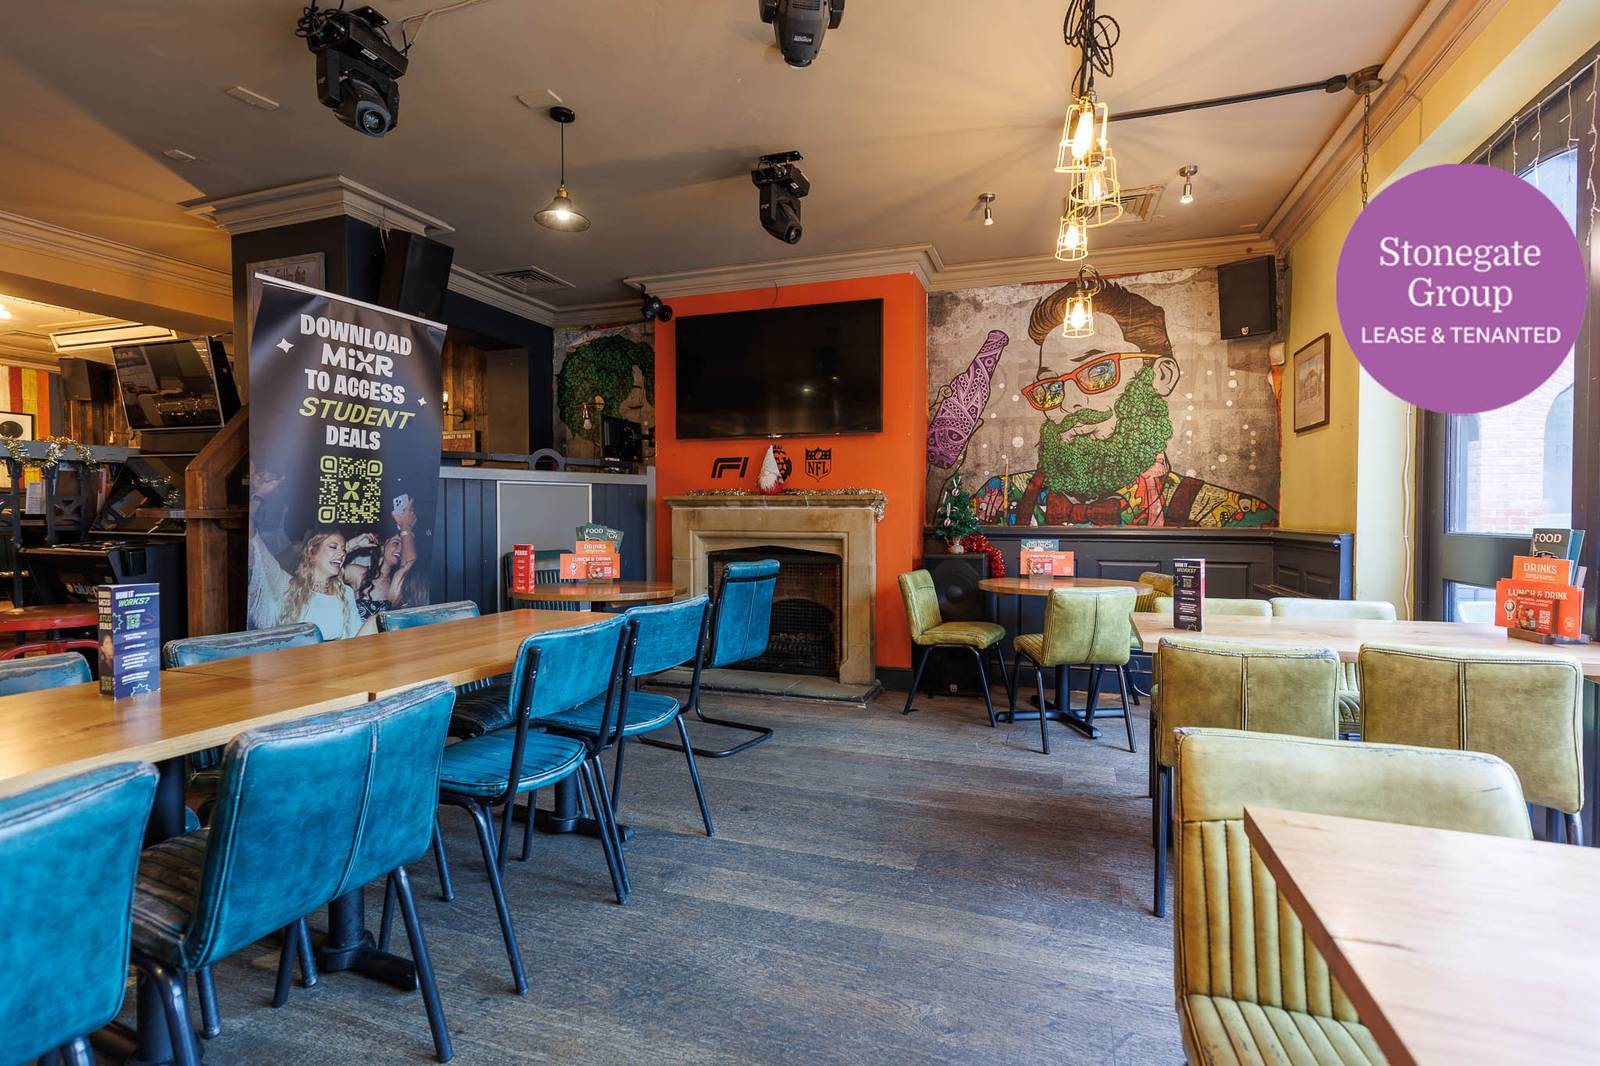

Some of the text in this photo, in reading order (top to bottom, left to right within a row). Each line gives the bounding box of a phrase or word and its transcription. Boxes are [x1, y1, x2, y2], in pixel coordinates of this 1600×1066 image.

[300, 313, 412, 356] DOWNLOAD
[304, 368, 406, 405] TO ACCESS
[299, 396, 416, 430] STUDENT
[326, 425, 381, 451] DEALS
[807, 460, 829, 476] NFL
[1534, 533, 1562, 544] FOOD
[1523, 562, 1558, 575] DRINKS
[118, 597, 151, 608] WORKS?
[1507, 588, 1536, 597] LUNCH
[1544, 591, 1568, 601] DRINK
